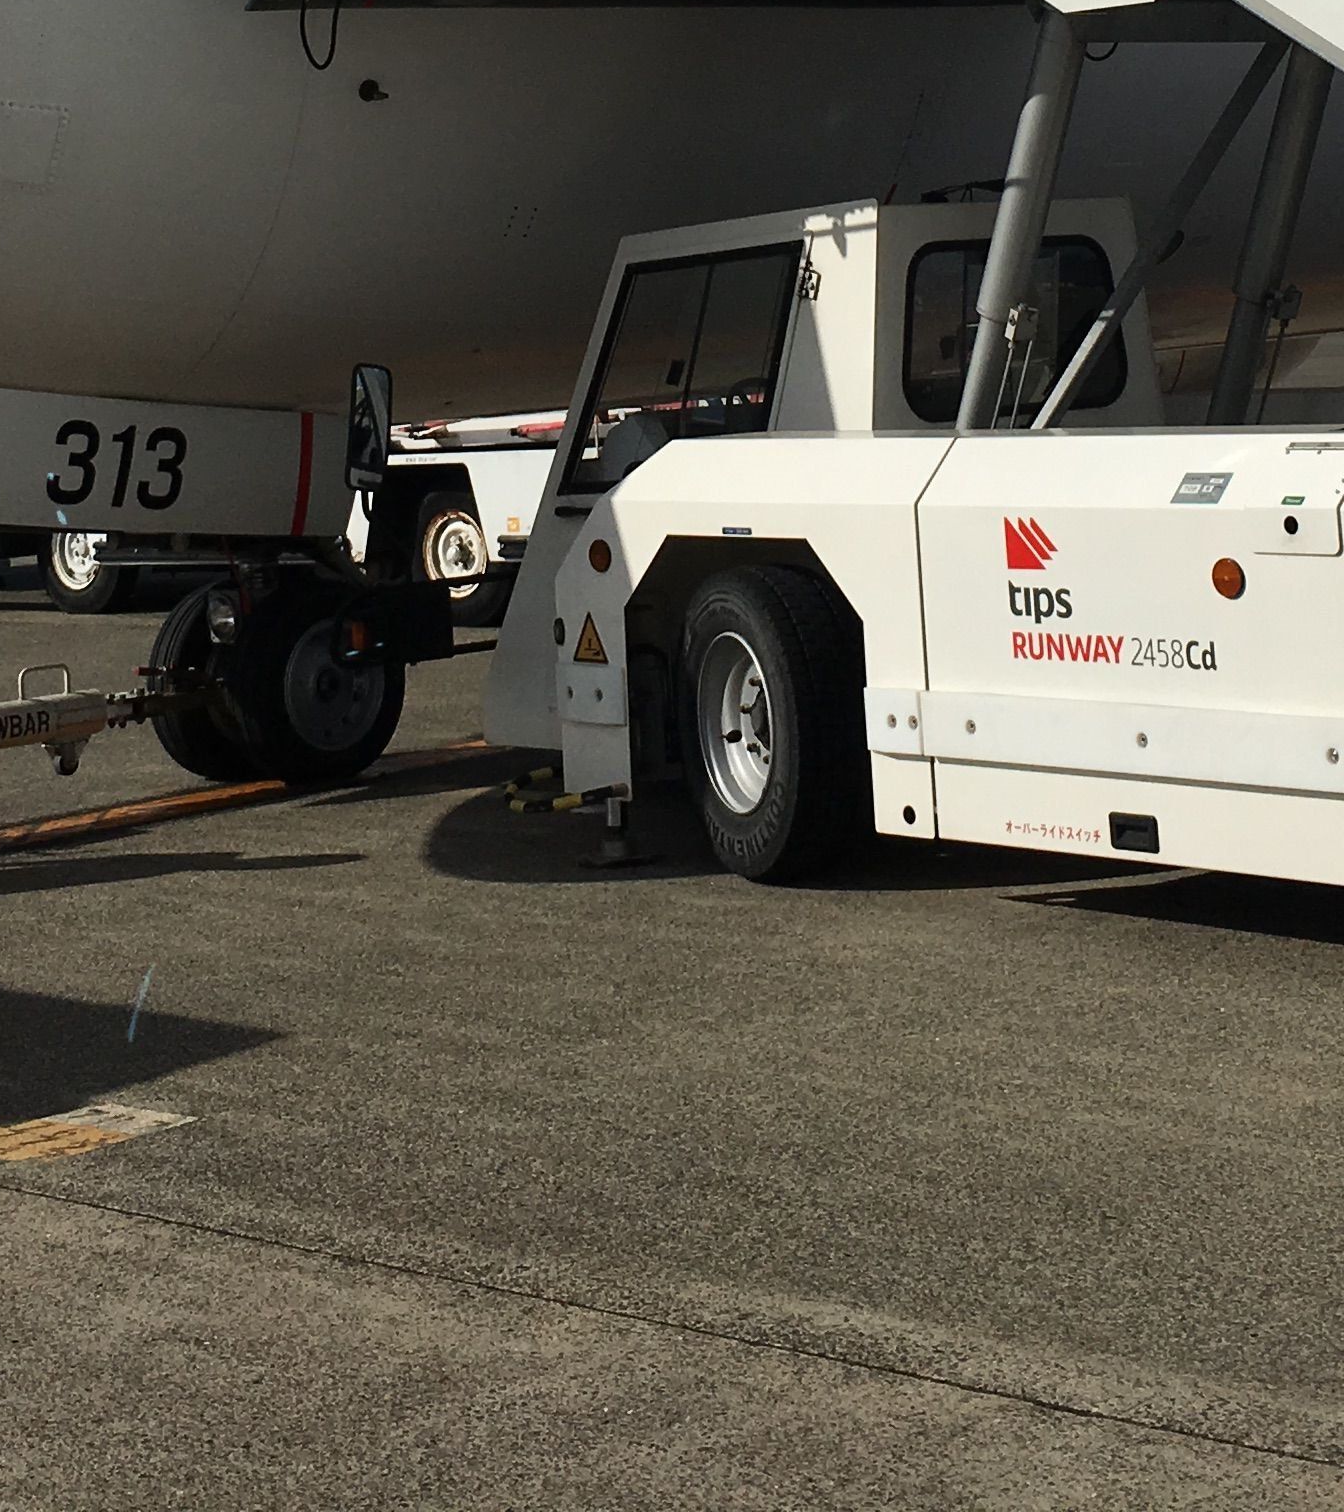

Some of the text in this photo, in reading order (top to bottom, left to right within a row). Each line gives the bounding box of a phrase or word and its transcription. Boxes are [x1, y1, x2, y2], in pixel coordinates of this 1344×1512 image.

[46, 419, 188, 510] 313
[1008, 580, 1073, 624] tips
[1012, 632, 1218, 671] RUNWAY 2458Cd
[1005, 820, 1102, 843] オーバーライドスイッチ
